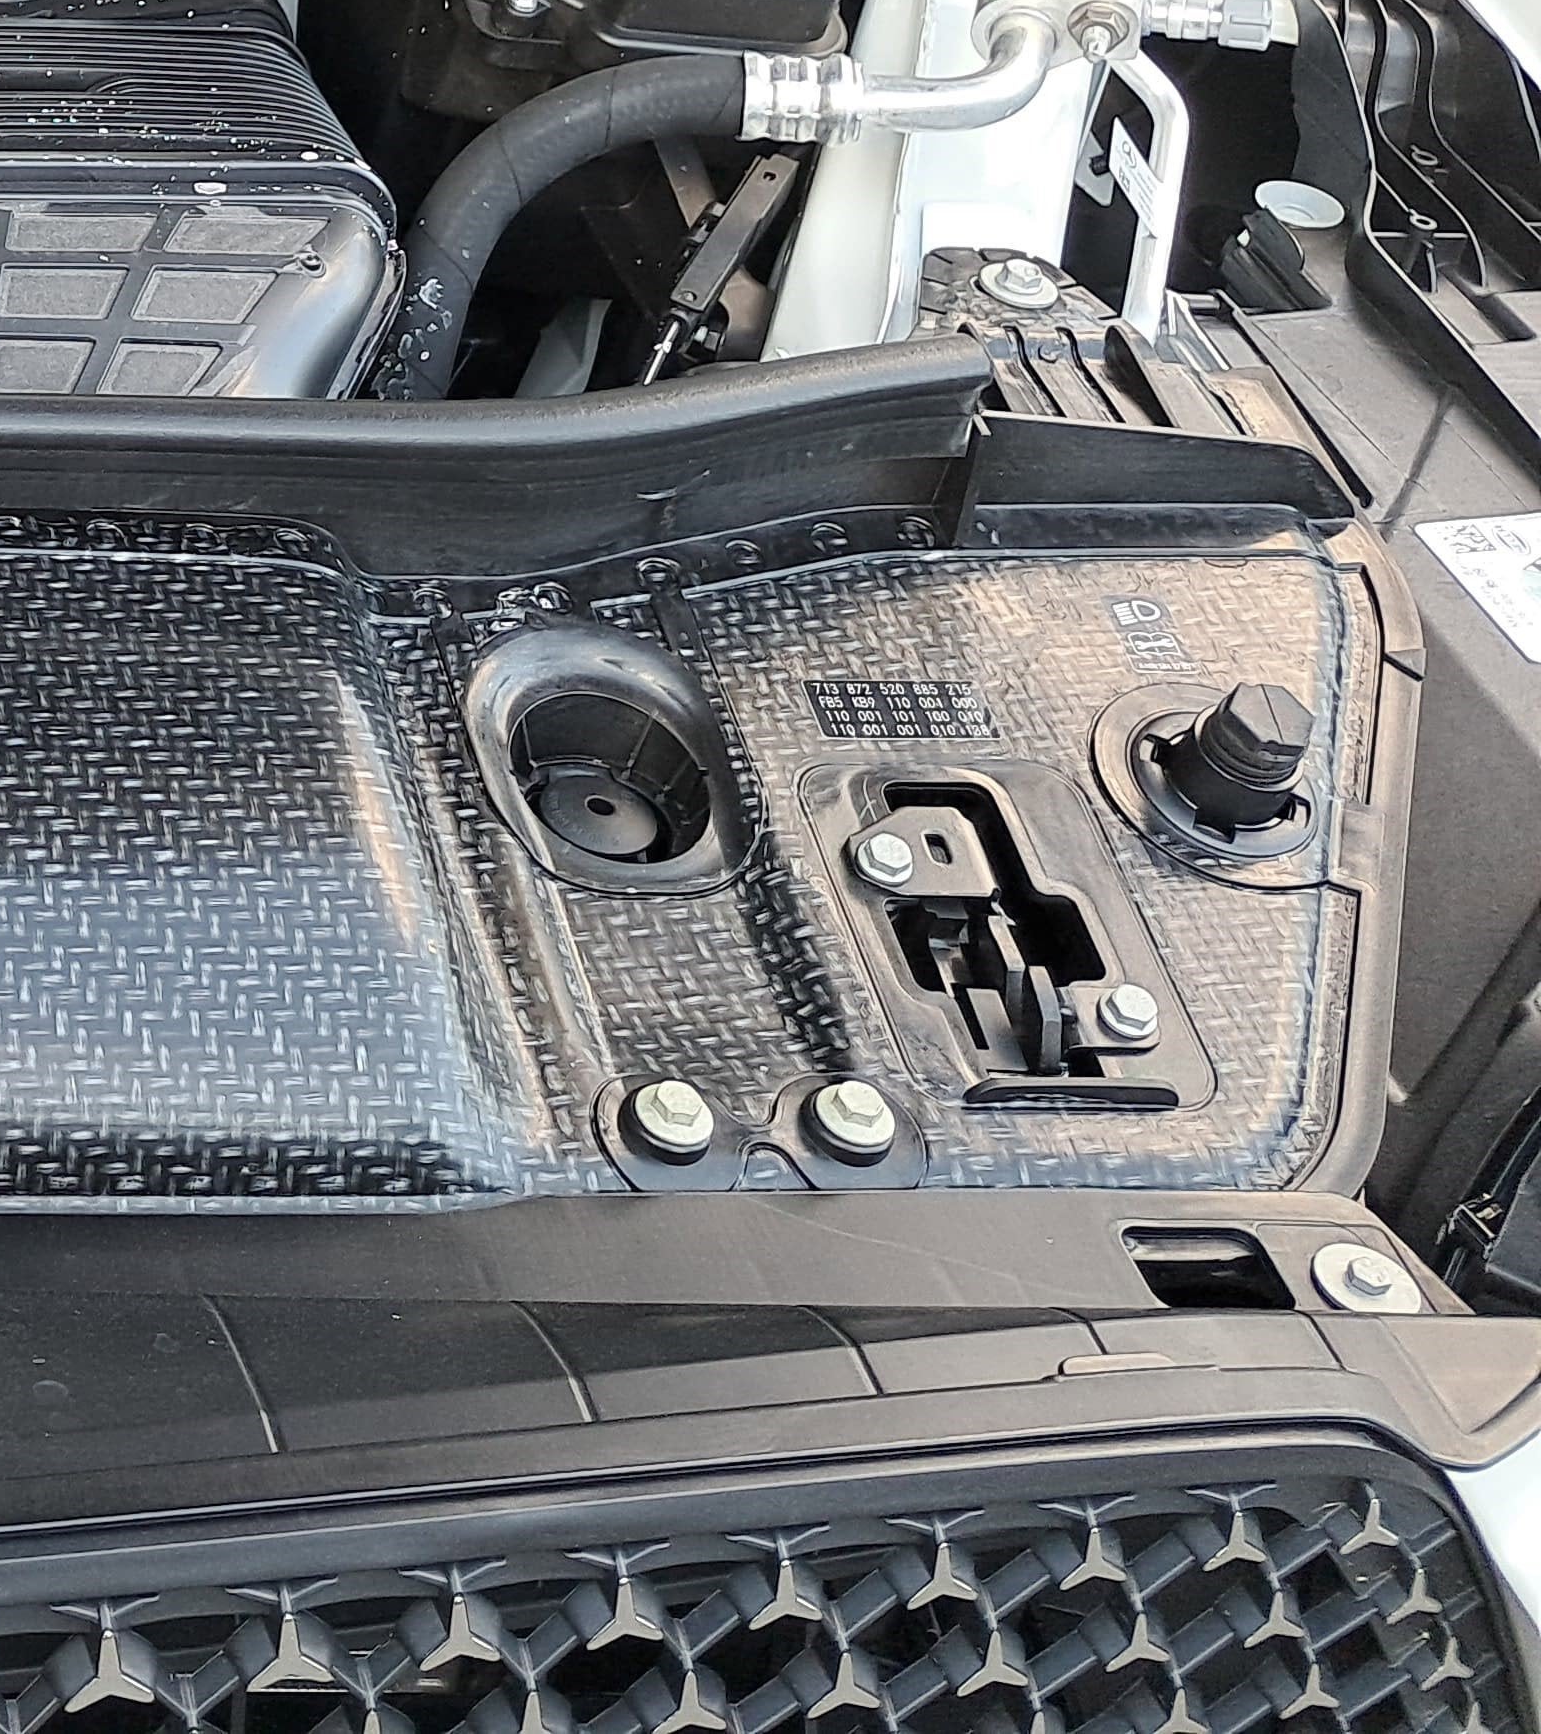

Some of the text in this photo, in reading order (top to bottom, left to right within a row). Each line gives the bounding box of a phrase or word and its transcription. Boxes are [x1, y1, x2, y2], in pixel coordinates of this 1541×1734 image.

[846, 683, 873, 695] 872
[879, 683, 905, 695] 520
[945, 683, 972, 695] 215
[886, 697, 911, 709] 110
[918, 697, 943, 709] 001
[951, 697, 977, 709] 000
[825, 710, 850, 722] 110
[858, 710, 883, 722] 001
[892, 710, 916, 722] 101
[958, 710, 984, 722] 010
[830, 724, 856, 736] 110
[862, 724, 888, 736] 001
[897, 724, 922, 736] 001
[930, 724, 956, 736] 010
